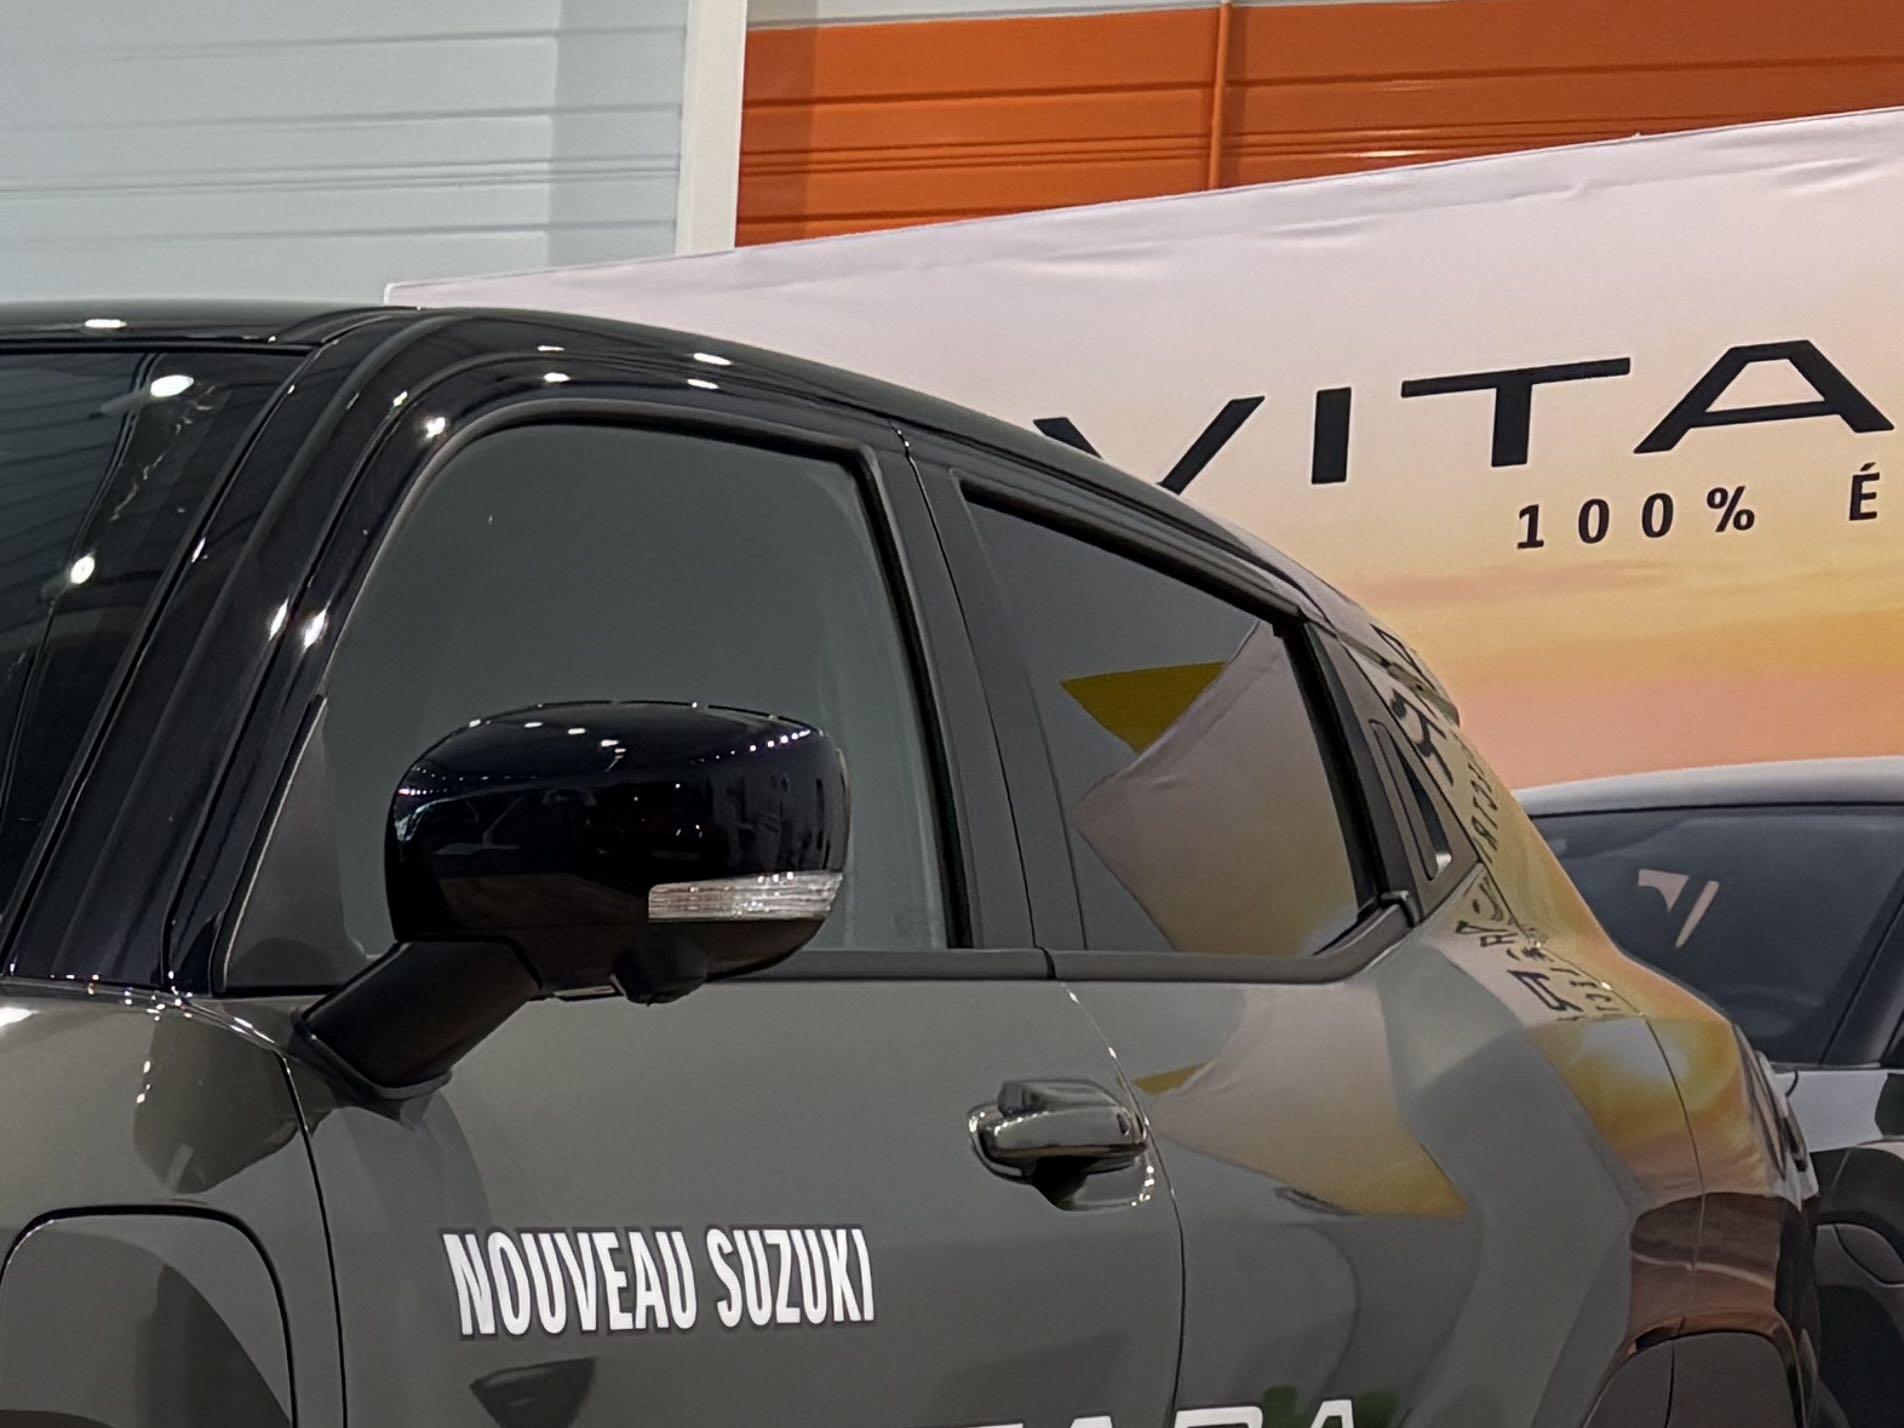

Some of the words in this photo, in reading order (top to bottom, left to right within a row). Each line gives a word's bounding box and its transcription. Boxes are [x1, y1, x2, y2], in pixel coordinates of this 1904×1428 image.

[1516, 486, 1756, 550] 100%
[442, 1231, 698, 1336] NOUVEAU
[705, 1228, 875, 1328] SUZUKI
